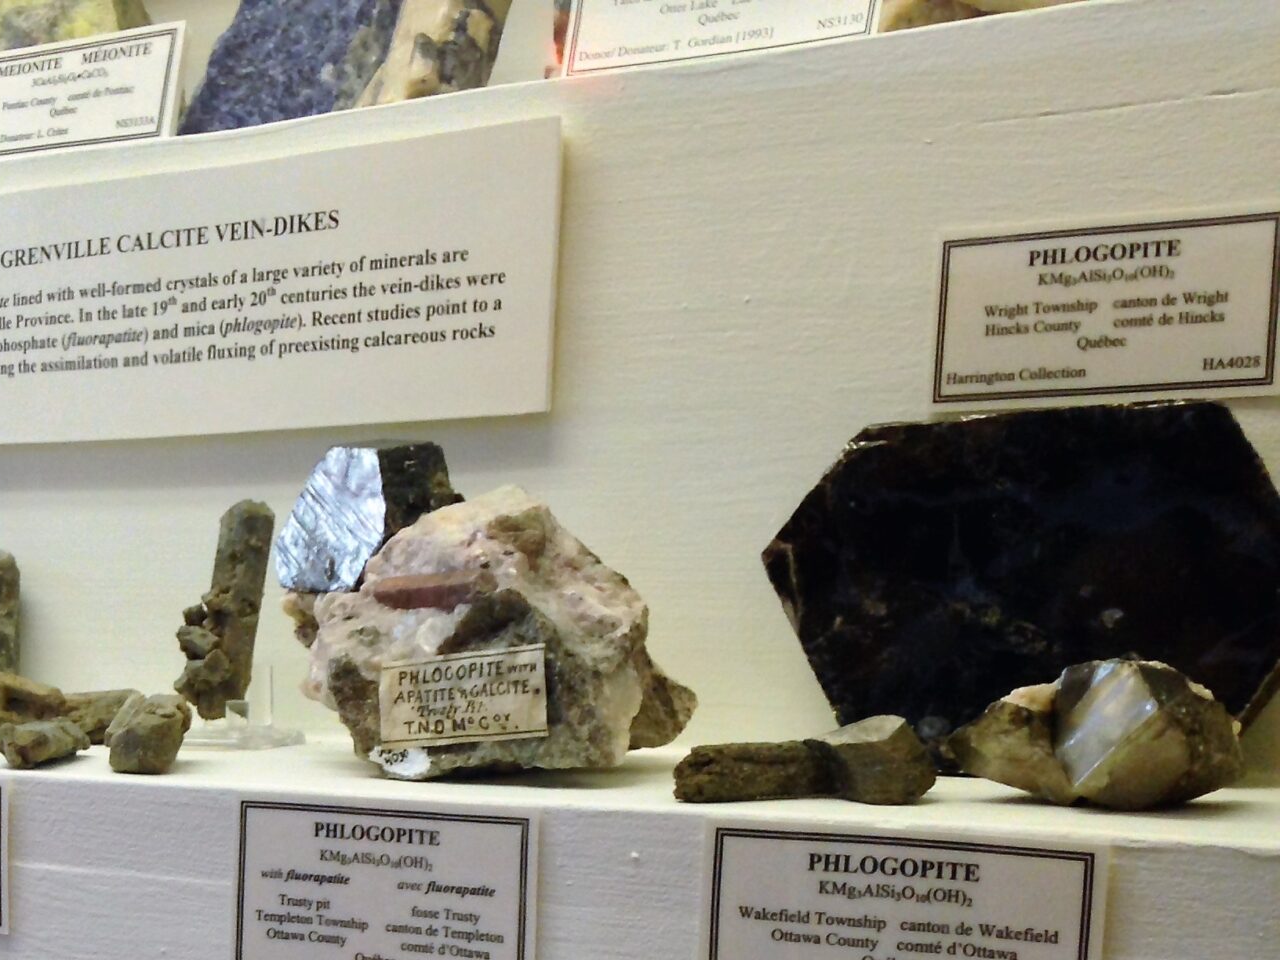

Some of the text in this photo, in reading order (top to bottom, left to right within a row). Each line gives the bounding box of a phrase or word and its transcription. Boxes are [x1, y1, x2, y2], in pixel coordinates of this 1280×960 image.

[1, 210, 339, 268] GRENVILLE CALCITE VEIN-DIKES
[1029, 239, 1181, 266] PHLOGOPITE
[13, 292, 42, 306] lined
[47, 288, 74, 303] with
[79, 278, 161, 299] well-formed
[166, 271, 218, 292] crystals
[223, 270, 239, 286] of
[240, 272, 247, 284] a
[252, 266, 288, 284] large
[294, 260, 345, 278] variety
[350, 256, 366, 272] of
[370, 249, 437, 271] minerals
[442, 249, 469, 262] are
[985, 290, 1229, 320] Wright Township canton de Wright
[61, 331, 148, 351] (fluorapatite)
[153, 325, 178, 340] and
[183, 324, 215, 338] mica
[220, 315, 306, 335] (phlogopite).
[311, 311, 362, 327] Recent
[367, 305, 420, 322] studies
[425, 301, 467, 318] point
[472, 298, 488, 312] to
[493, 299, 502, 311] a
[985, 310, 1225, 336] Hincks County comté de Hincks
[18, 360, 37, 373] the
[41, 353, 118, 371] assimilation
[123, 352, 148, 367] and
[153, 347, 203, 364] volatile
[207, 342, 255, 361] fluxing
[260, 339, 275, 355] of
[278, 333, 359, 359] preexisting
[364, 326, 446, 347] calcareous
[452, 322, 495, 340] rocks
[1077, 335, 1126, 351] Québec
[946, 355, 1261, 386] Harrington Collection HA4028
[394, 688, 455, 704] APATITE
[314, 821, 440, 846] PHLOGOPITE
[285, 869, 350, 885] fluorapatite
[397, 880, 423, 890] avec
[425, 881, 496, 898] fluorapatite
[808, 853, 980, 883] PHLOGOPITE
[278, 894, 480, 925] Trusty pit fosse Trusty
[739, 905, 1059, 944] Wakefield Township canton de Wakefield
[256, 910, 504, 944] Templeton Township canton de Templeton
[771, 929, 1018, 960] Ottawa County comté d'Ottawa
